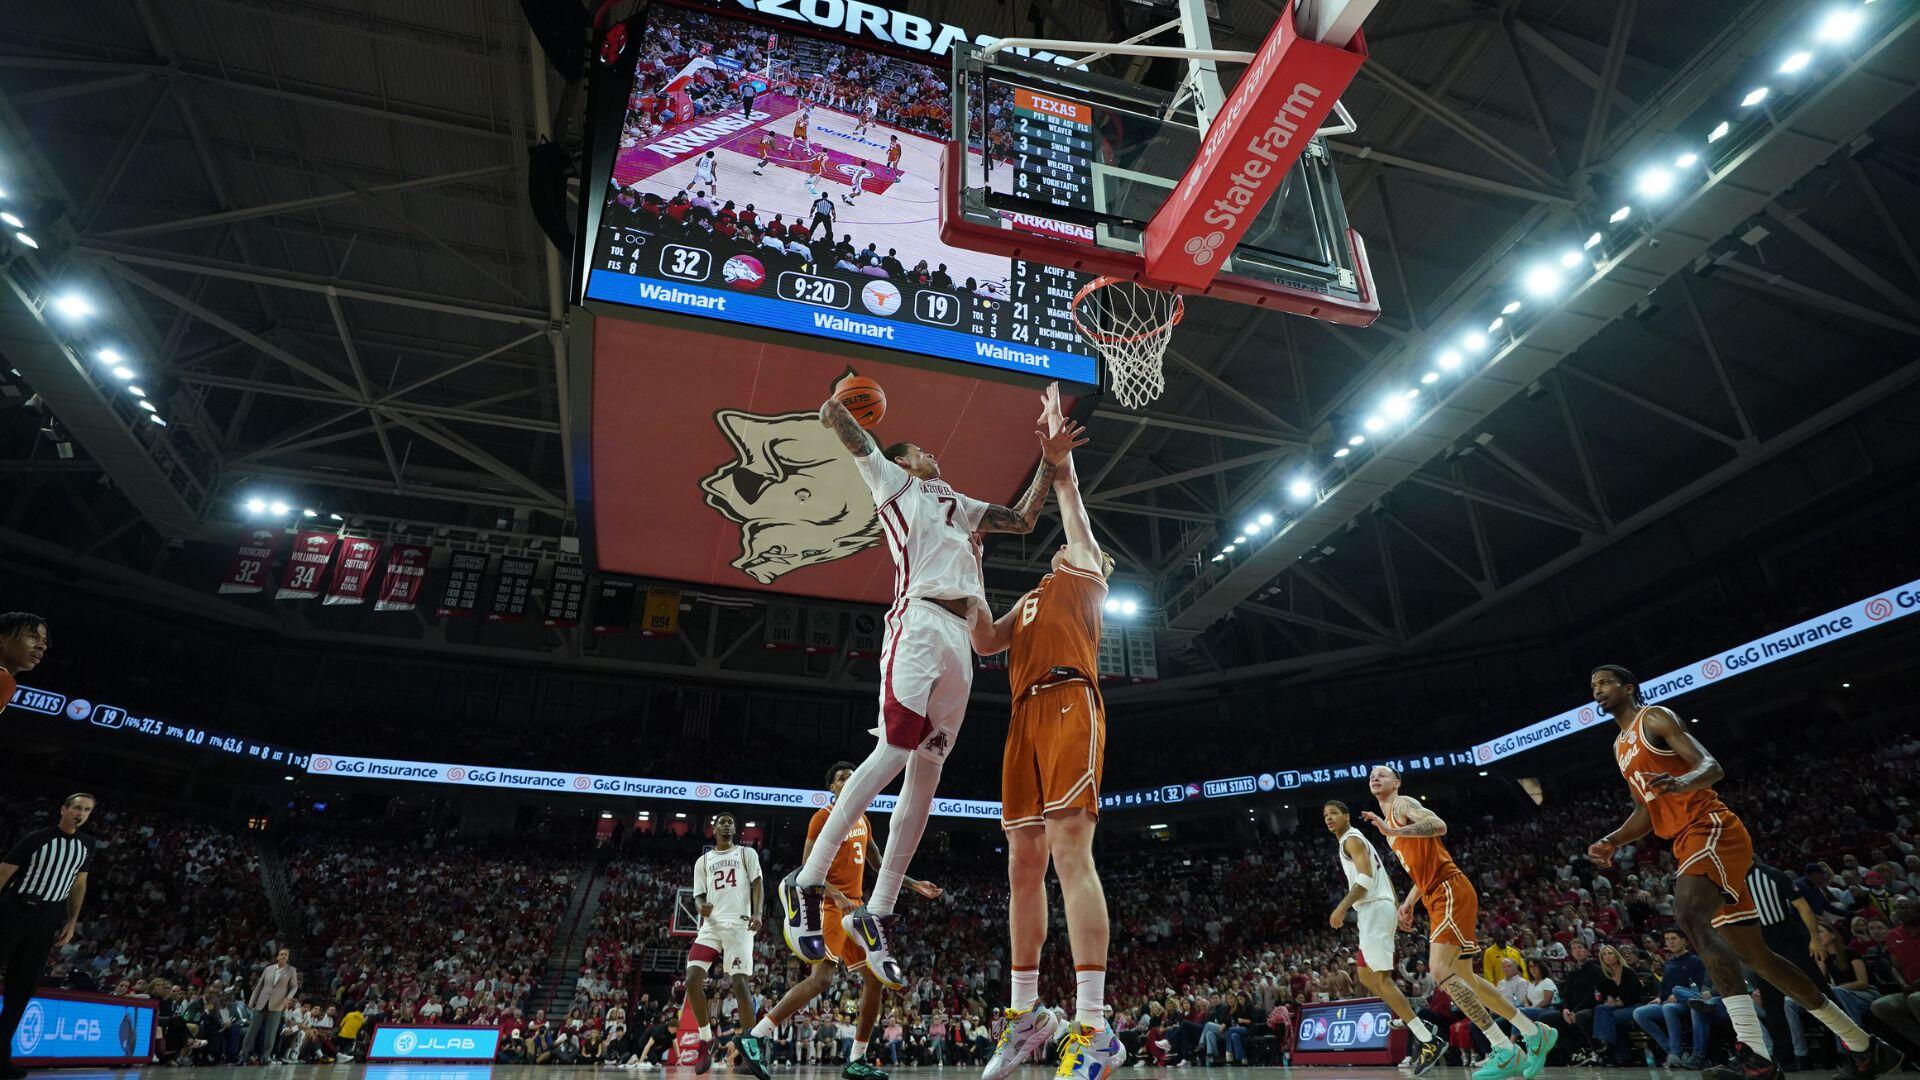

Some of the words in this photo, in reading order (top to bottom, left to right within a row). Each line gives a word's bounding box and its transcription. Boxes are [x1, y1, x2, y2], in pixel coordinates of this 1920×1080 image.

[1031, 96, 1076, 117] TEXAS
[1020, 118, 1028, 133] 2
[1048, 124, 1072, 137] WEAVER
[1033, 112, 1045, 121] PTS
[1063, 120, 1074, 128] AST
[1077, 123, 1089, 132] FLS
[1020, 136, 1028, 151] 3
[1051, 142, 1070, 154] SWAIN
[1081, 141, 1086, 149] 0
[1019, 154, 1028, 169] 7
[1047, 160, 1074, 173] WILCHER
[1204, 82, 1322, 231] StateFarm
[1052, 169, 1056, 177] 0
[1019, 173, 1028, 188] 8
[1042, 176, 1079, 192] VOKIETAITIS
[1036, 184, 1041, 192] 4
[1081, 195, 1086, 203] 0
[1013, 212, 1094, 240] ARKANSAS
[614, 233, 620, 241] B
[611, 246, 624, 257] TOL
[632, 249, 640, 260] 4
[608, 260, 621, 270] FLS
[629, 262, 637, 274] 8
[672, 249, 700, 276] 32
[812, 264, 817, 275] 1
[1017, 260, 1026, 277] 5
[1044, 266, 1065, 277] ACUFF
[794, 278, 835, 304] 9:20
[1017, 281, 1026, 297] 7
[1047, 287, 1074, 300] BRAZILE
[1035, 274, 1040, 282] 5
[1067, 282, 1072, 290] 5
[640, 283, 726, 311] Walmart
[1035, 295, 1040, 303] 9
[1067, 302, 1072, 310] 0
[927, 295, 948, 320] 19
[1013, 302, 1028, 320] 21
[813, 312, 894, 340] Walmart
[972, 311, 984, 321] TOL
[991, 314, 997, 324] 3
[1035, 316, 1040, 324] 2
[1051, 319, 1056, 328] 0
[972, 325, 984, 334] FLS
[990, 327, 996, 338] 5
[1012, 324, 1028, 342] 24
[1039, 327, 1073, 342] RICHMOND
[1034, 338, 1039, 347] 4
[1051, 341, 1056, 350] 3
[1067, 344, 1072, 352] 0
[975, 342, 1050, 368] Walmart
[919, 482, 954, 496] AZORB
[938, 497, 957, 528] 7
[292, 552, 330, 564] WILLIAMSON
[344, 559, 368, 570] SUTTON
[234, 560, 261, 583] 32
[290, 565, 316, 589] 34
[1725, 648, 1760, 670] G&G
[1761, 616, 1853, 658] Insurance
[1640, 674, 1693, 701] urance
[22, 692, 60, 711] STATS
[101, 709, 118, 724] 19
[139, 718, 163, 735] 37.5
[165, 726, 183, 738] 3PT%
[185, 729, 205, 744] 0.0
[209, 736, 223, 747] FT%
[222, 738, 243, 754] 63.6
[261, 746, 270, 759] 8
[272, 751, 283, 760] AST
[286, 752, 294, 765] 1
[301, 756, 309, 768] 3
[1494, 738, 1514, 755] G&G
[1516, 719, 1571, 747] Insurance
[335, 760, 365, 773] G&G
[367, 762, 438, 779] Insurance
[1312, 769, 1331, 783] 37.5
[1351, 765, 1367, 778] 0.0
[1423, 757, 1430, 769] 8
[1449, 753, 1456, 765] 1
[1465, 751, 1473, 764] 3
[468, 771, 496, 783] G&G
[498, 772, 566, 788] Insurance
[594, 779, 620, 790] G&G
[623, 781, 687, 796] Insurance
[1206, 782, 1228, 795] TEAM
[1229, 779, 1254, 792] STATS
[1283, 774, 1294, 786] 19
[714, 787, 740, 799] G&G
[743, 789, 803, 803] Insurance
[1115, 795, 1121, 806] 9
[1136, 792, 1141, 804] 6
[1154, 790, 1160, 802] 2
[1168, 788, 1178, 800] 32
[939, 802, 962, 813] G&G
[964, 803, 1002, 815] Insura
[853, 842, 864, 865] 3
[714, 868, 737, 890] 24
[44, 1017, 101, 1041] JLAB
[1303, 1024, 1311, 1036] 32
[1333, 1024, 1351, 1042] 9:20
[418, 1038, 475, 1049] JLAB
